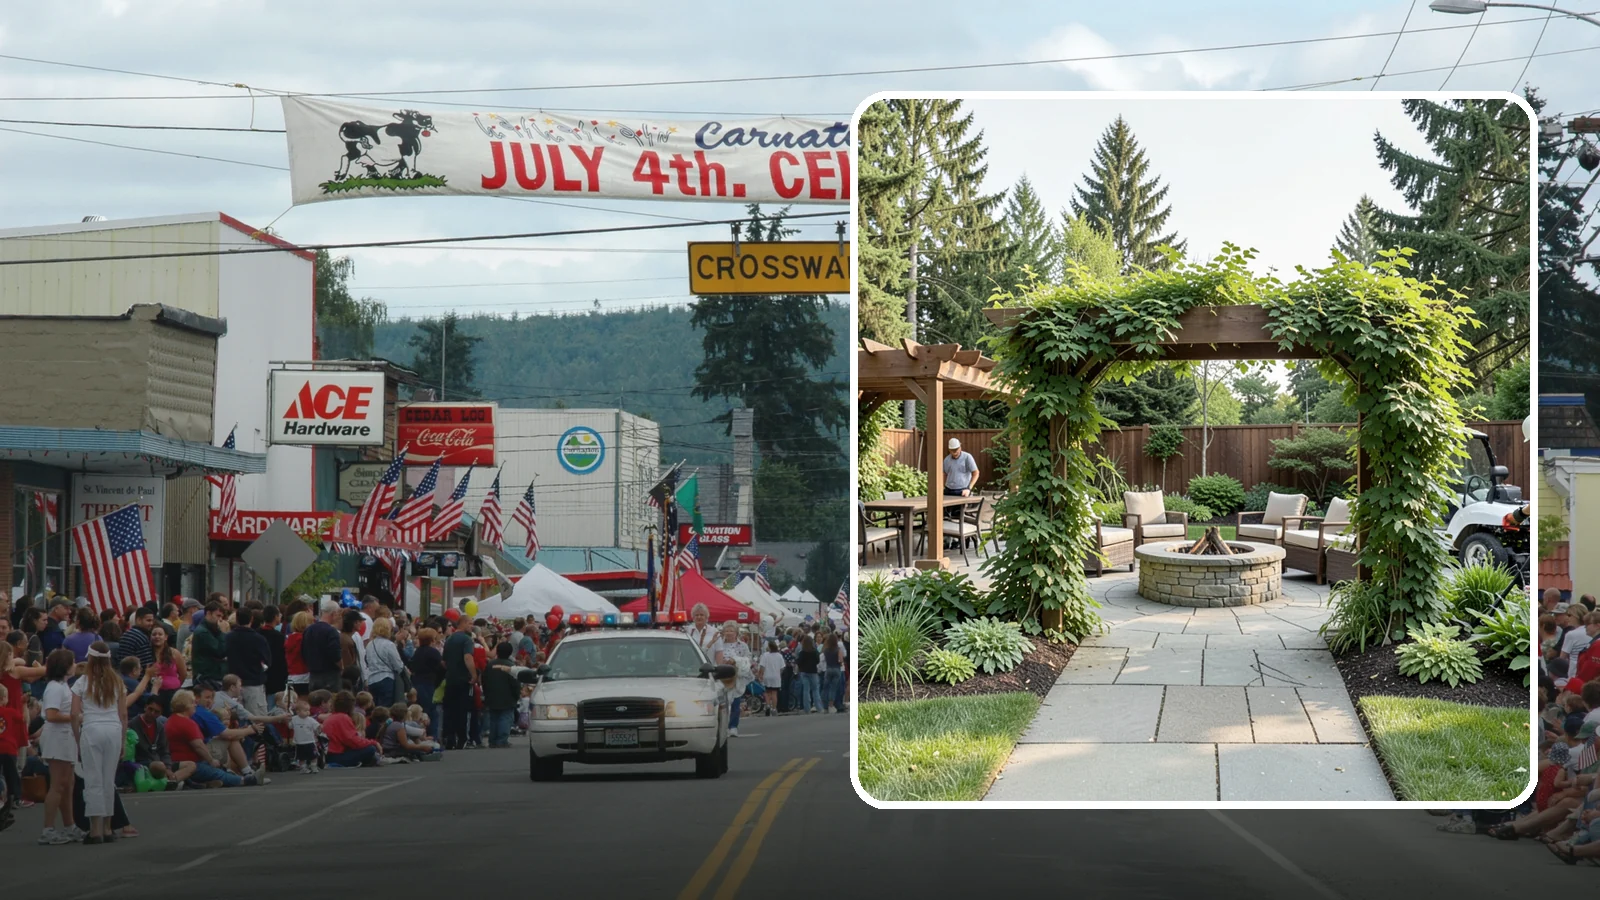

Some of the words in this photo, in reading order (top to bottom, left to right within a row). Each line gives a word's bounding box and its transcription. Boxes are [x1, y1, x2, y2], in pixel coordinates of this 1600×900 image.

[695, 121, 850, 150] Carnat
[480, 141, 604, 192] JULY
[633, 150, 747, 199] 4th.
[697, 254, 850, 280] CROSSWA
[282, 379, 374, 420] ACE
[406, 409, 453, 422] CEDAR
[283, 421, 371, 437] Hardware
[416, 428, 477, 447] Coca-Cola
[353, 467, 385, 481] Simpl
[95, 485, 125, 495] Vincent
[126, 485, 136, 495] de
[137, 485, 155, 495] Paul
[688, 526, 741, 535] CRNATION
[699, 535, 730, 543] GLASS
